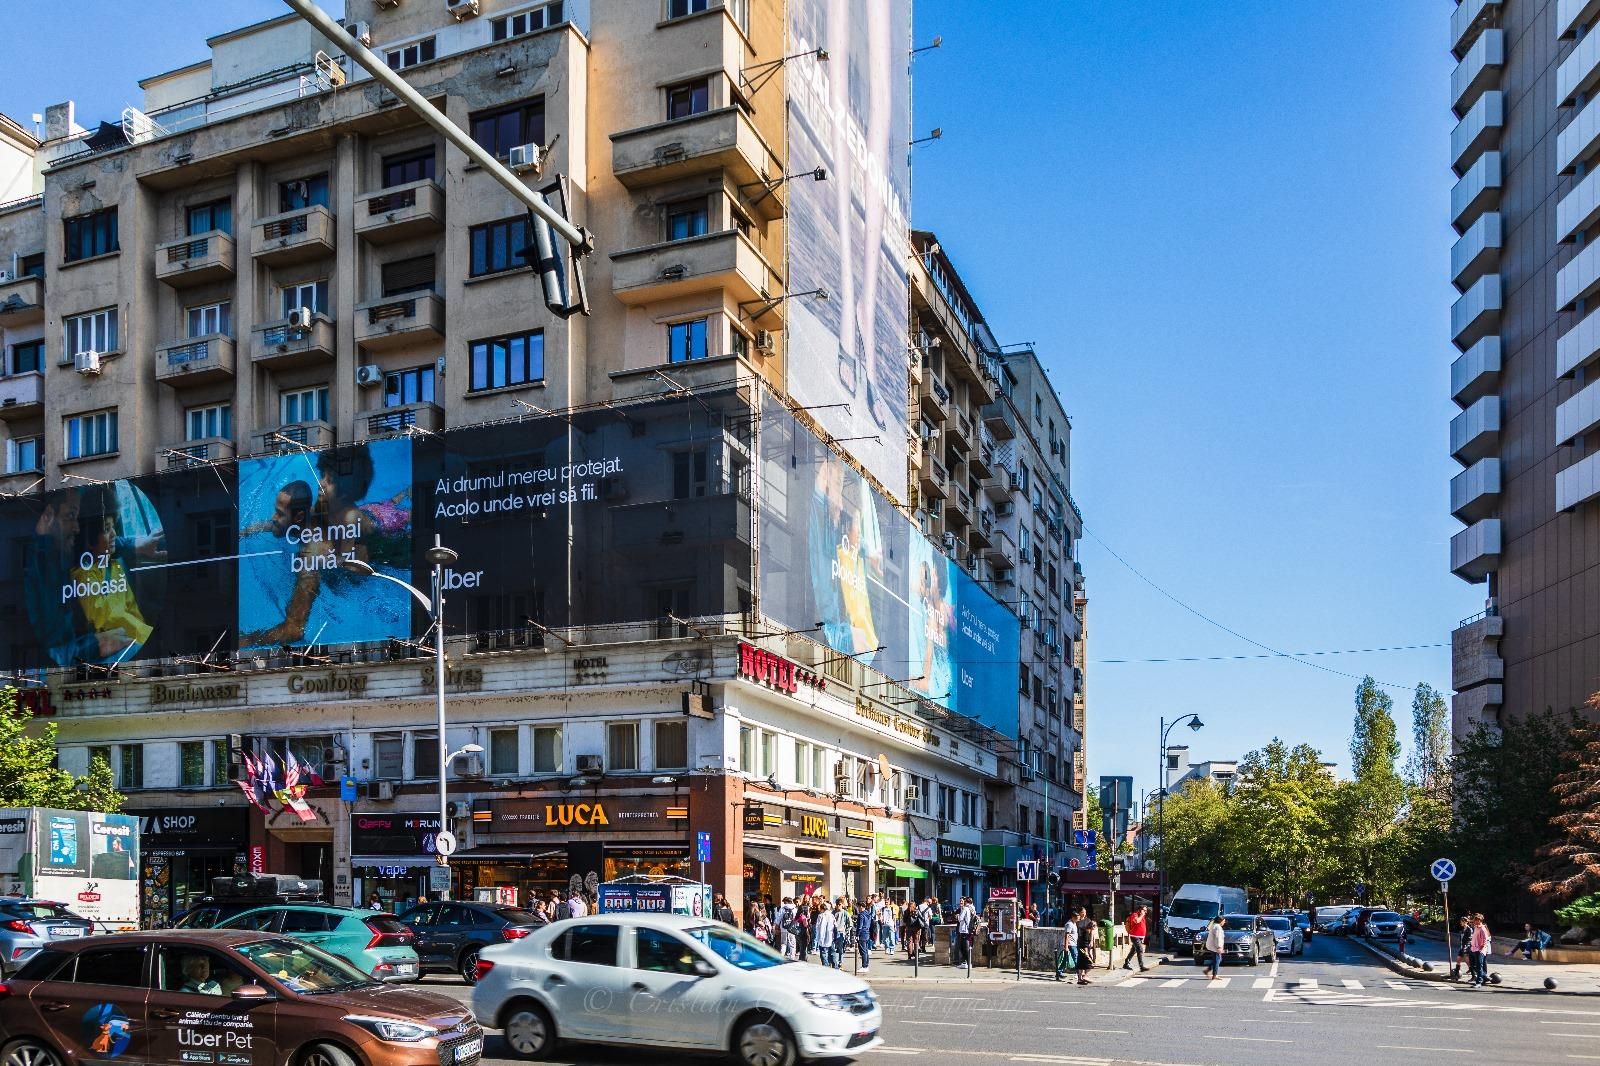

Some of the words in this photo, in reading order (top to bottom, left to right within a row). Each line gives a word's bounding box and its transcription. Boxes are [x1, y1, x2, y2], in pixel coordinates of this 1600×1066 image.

[435, 478, 450, 495] Ai
[453, 471, 504, 493] drumul
[508, 469, 557, 487] mereu
[561, 455, 624, 479] protejat.
[435, 500, 479, 519] Acolo
[483, 494, 523, 513] unde
[527, 489, 556, 508] vrei
[559, 488, 578, 505] să
[580, 483, 598, 501] fii.
[285, 523, 324, 546] Cea
[328, 517, 361, 541] mai
[80, 551, 94, 570] O
[97, 549, 109, 569] zi
[290, 553, 338, 574] bună
[343, 546, 357, 564] zi
[62, 576, 127, 603] ploioasă
[573, 656, 608, 669] HOTEL
[737, 642, 798, 694] HOTEL
[421, 667, 483, 688] SITES
[163, 815, 196, 828] SHOP
[545, 803, 609, 826] LUCA
[94, 823, 131, 837] Ceresit
[802, 815, 829, 838] LUCA
[378, 864, 407, 878] vape
[1018, 862, 1036, 880] M
[210, 1012, 231, 1020] pentru
[177, 1028, 223, 1047] Uber
[226, 1031, 253, 1049] Pet
